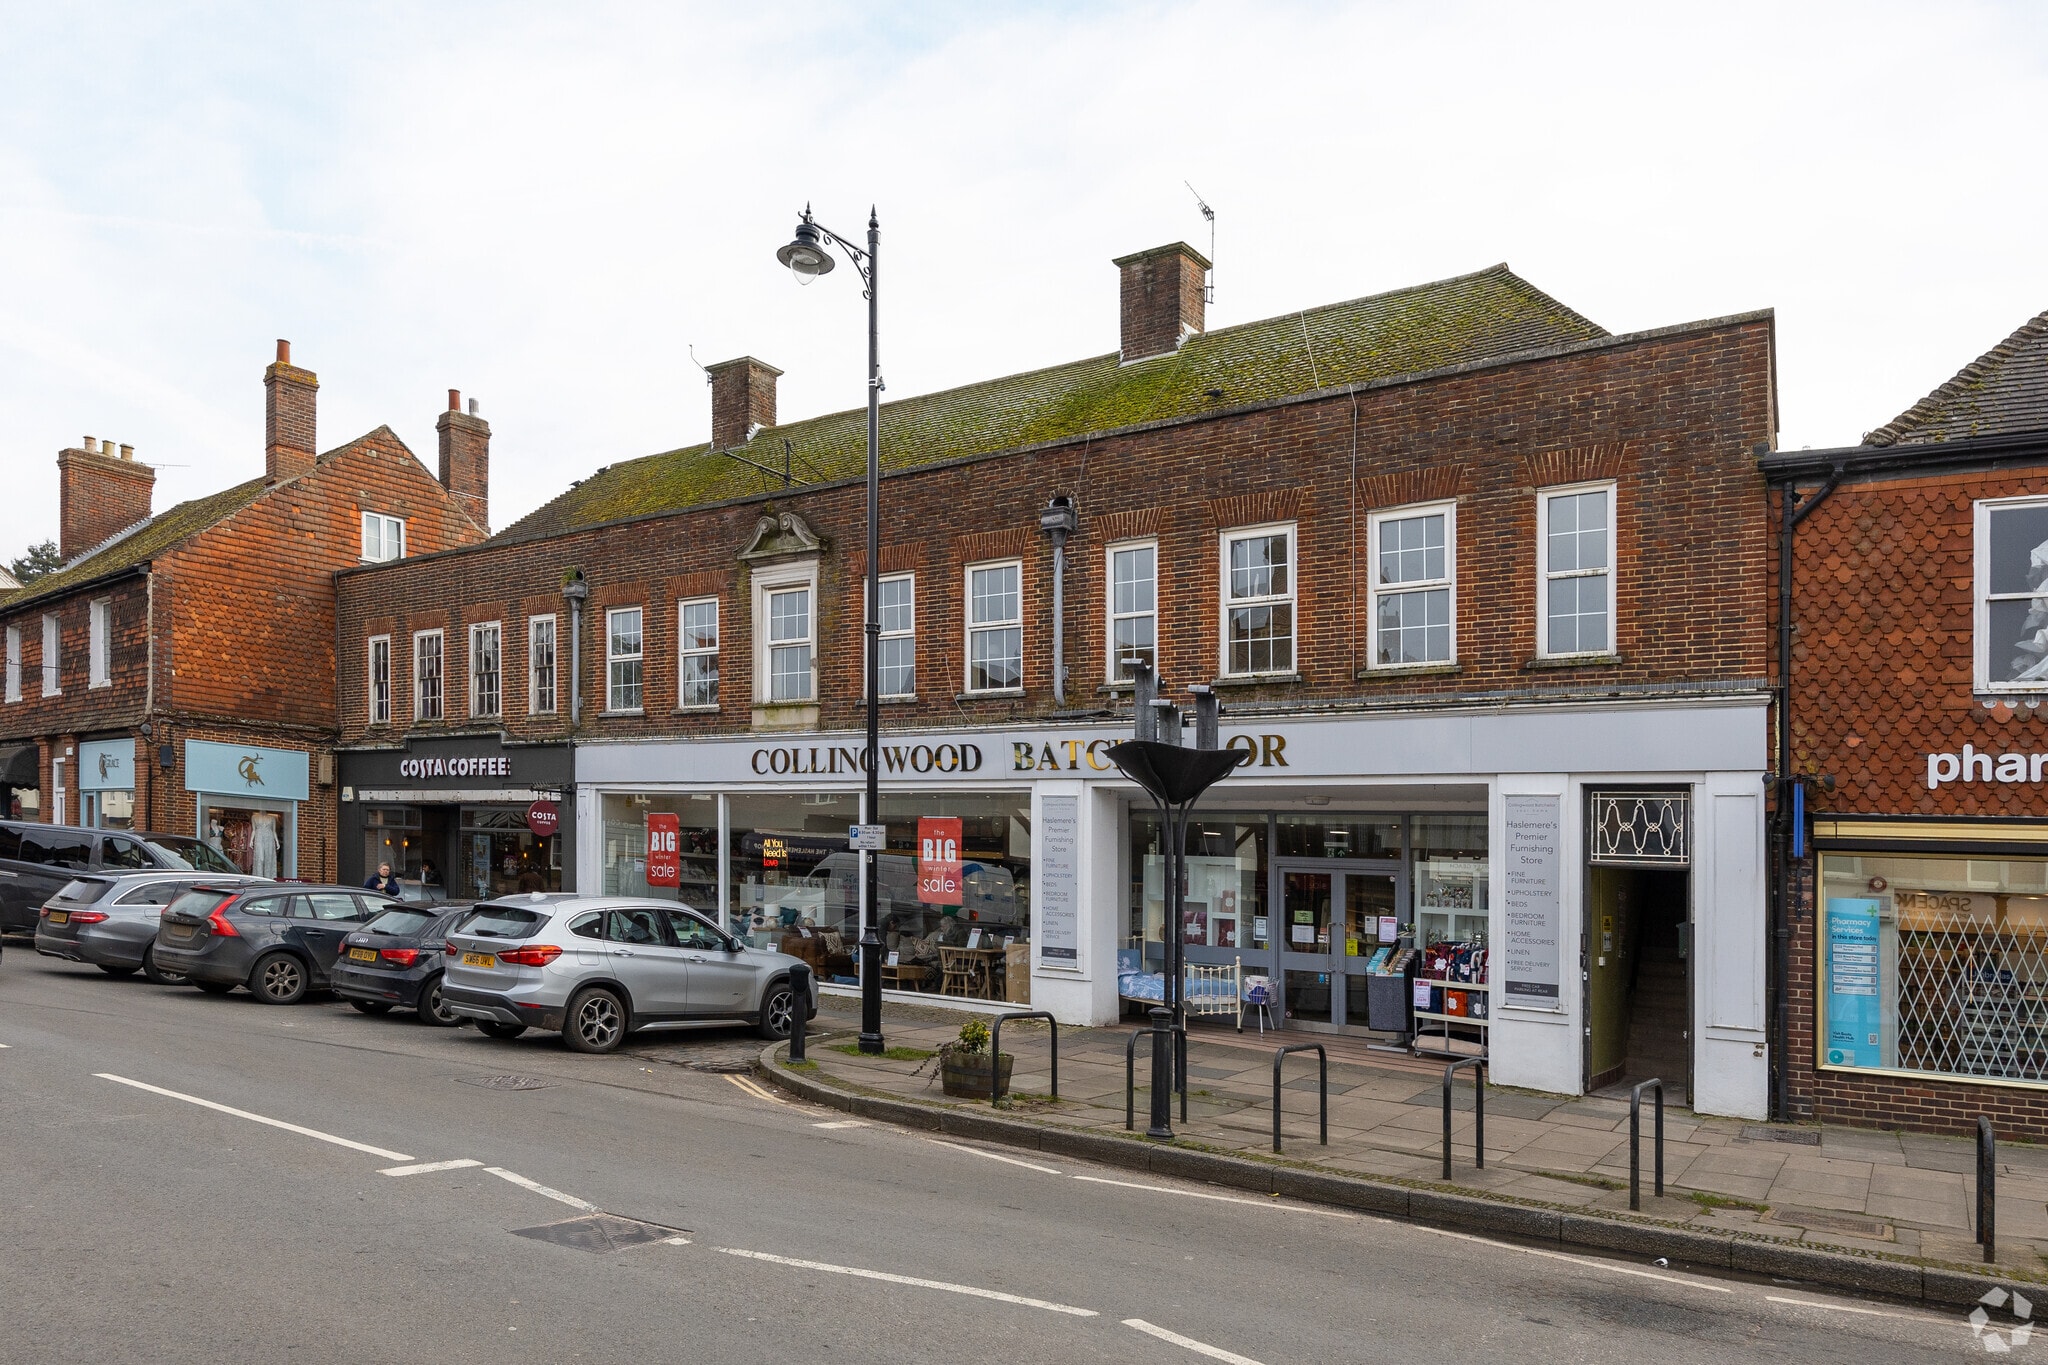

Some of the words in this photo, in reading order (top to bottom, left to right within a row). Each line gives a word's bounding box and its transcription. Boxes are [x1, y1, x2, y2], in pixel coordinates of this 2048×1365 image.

[400, 758, 444, 779] COSTA
[448, 757, 509, 777] COFFEE
[1927, 743, 2048, 790] phar
[531, 811, 557, 821] COSTA
[1506, 820, 1558, 829] Haslemere's
[1045, 836, 1074, 844] Furnishing
[1515, 832, 1548, 841] Premier
[651, 831, 676, 852] BIG
[771, 838, 783, 848] You
[763, 848, 780, 858] Need
[922, 838, 957, 863] BIG
[1051, 845, 1067, 853] Store
[1510, 843, 1554, 855] Furnishing
[763, 858, 779, 867] Love
[1520, 855, 1543, 864] Store
[651, 863, 675, 877] sale
[923, 875, 956, 893] sale
[1511, 889, 1552, 897] UPHOLSTERY
[1511, 912, 1545, 920] BEDROOM
[1511, 919, 1546, 927] FURNITURE
[1831, 917, 1872, 928] Pharmacy
[1831, 926, 1864, 934] Services
[1511, 938, 1555, 946] ACCESSORIES
[1525, 960, 1550, 968] DELIVERY
